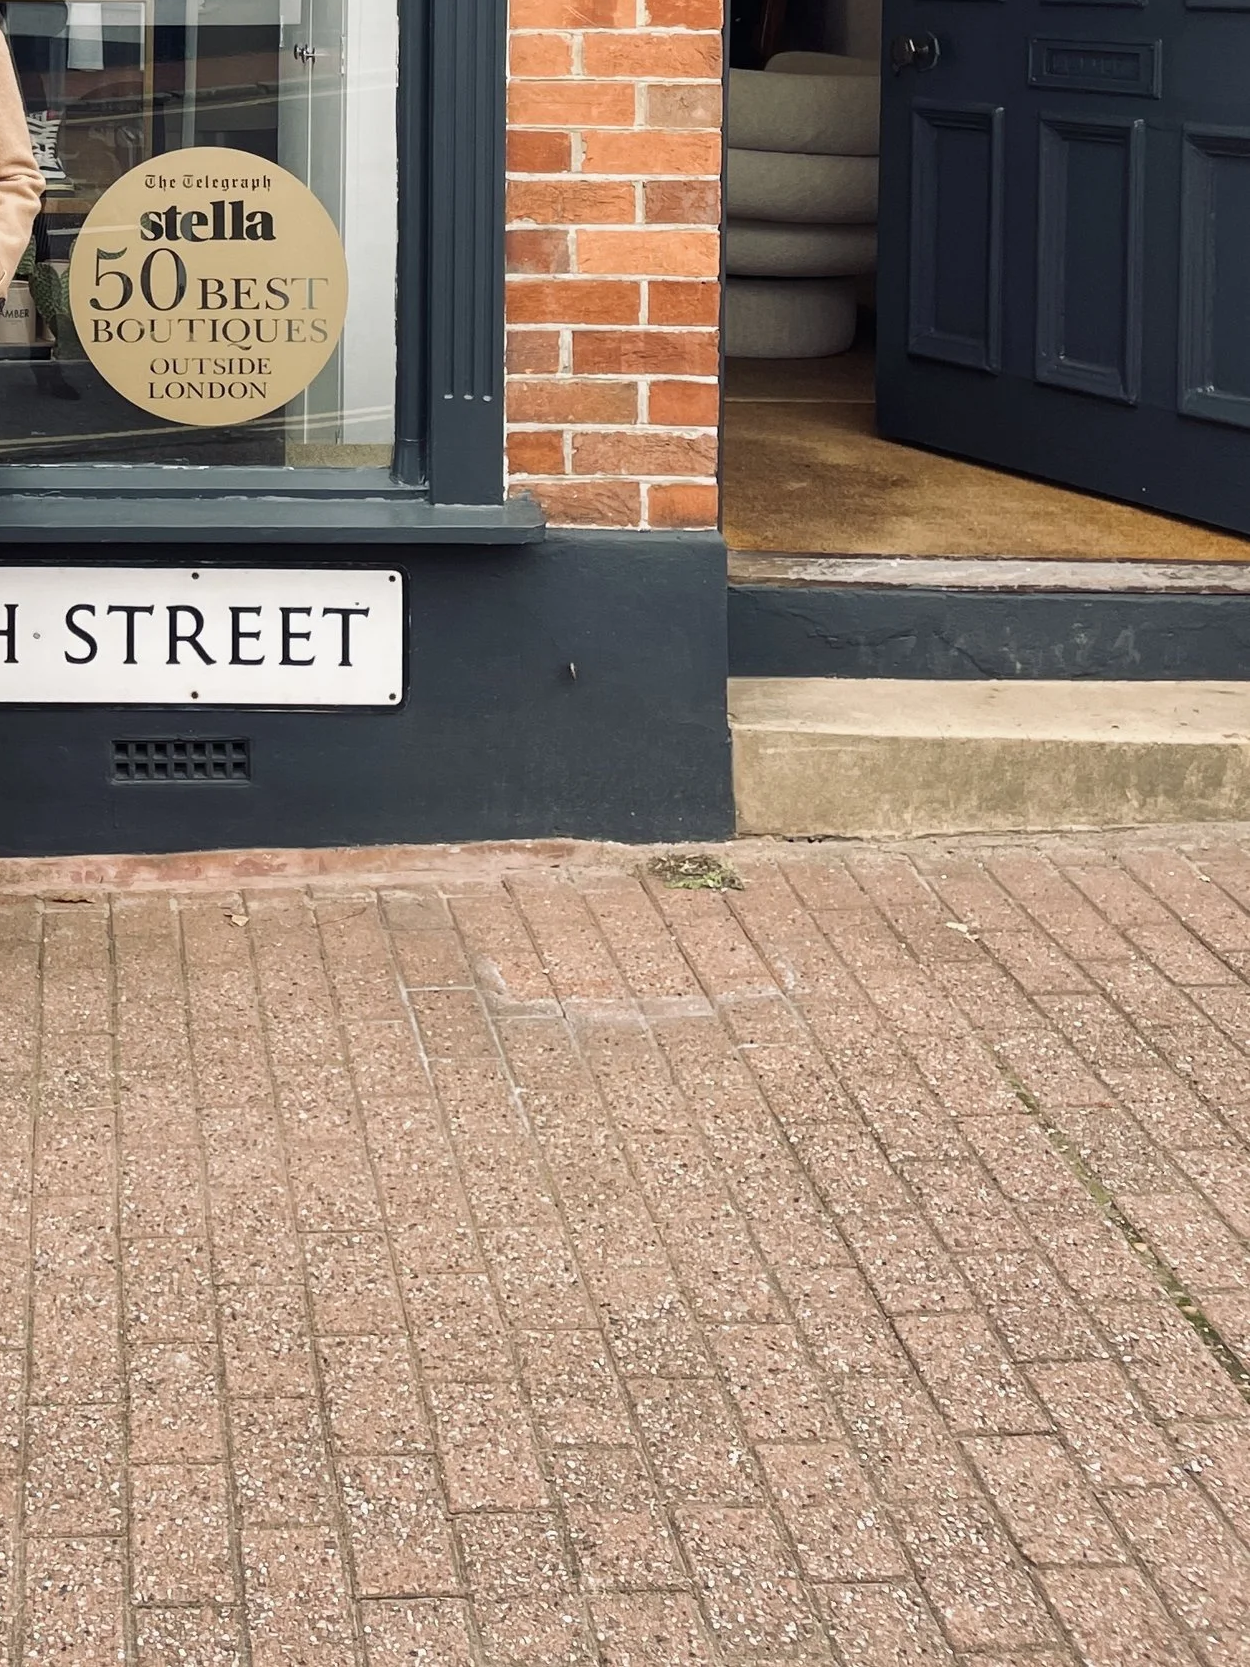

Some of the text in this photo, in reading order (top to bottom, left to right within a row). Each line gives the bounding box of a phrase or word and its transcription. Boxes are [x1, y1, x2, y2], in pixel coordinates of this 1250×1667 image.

[144, 174, 271, 192] The Telegraph
[140, 200, 276, 243] stella
[88, 247, 329, 312] 50 BEST
[91, 318, 329, 350] BOUTIQUES
[150, 357, 272, 376] OUTSIDE
[148, 381, 268, 400] LONDON
[64, 603, 371, 667] STREET
